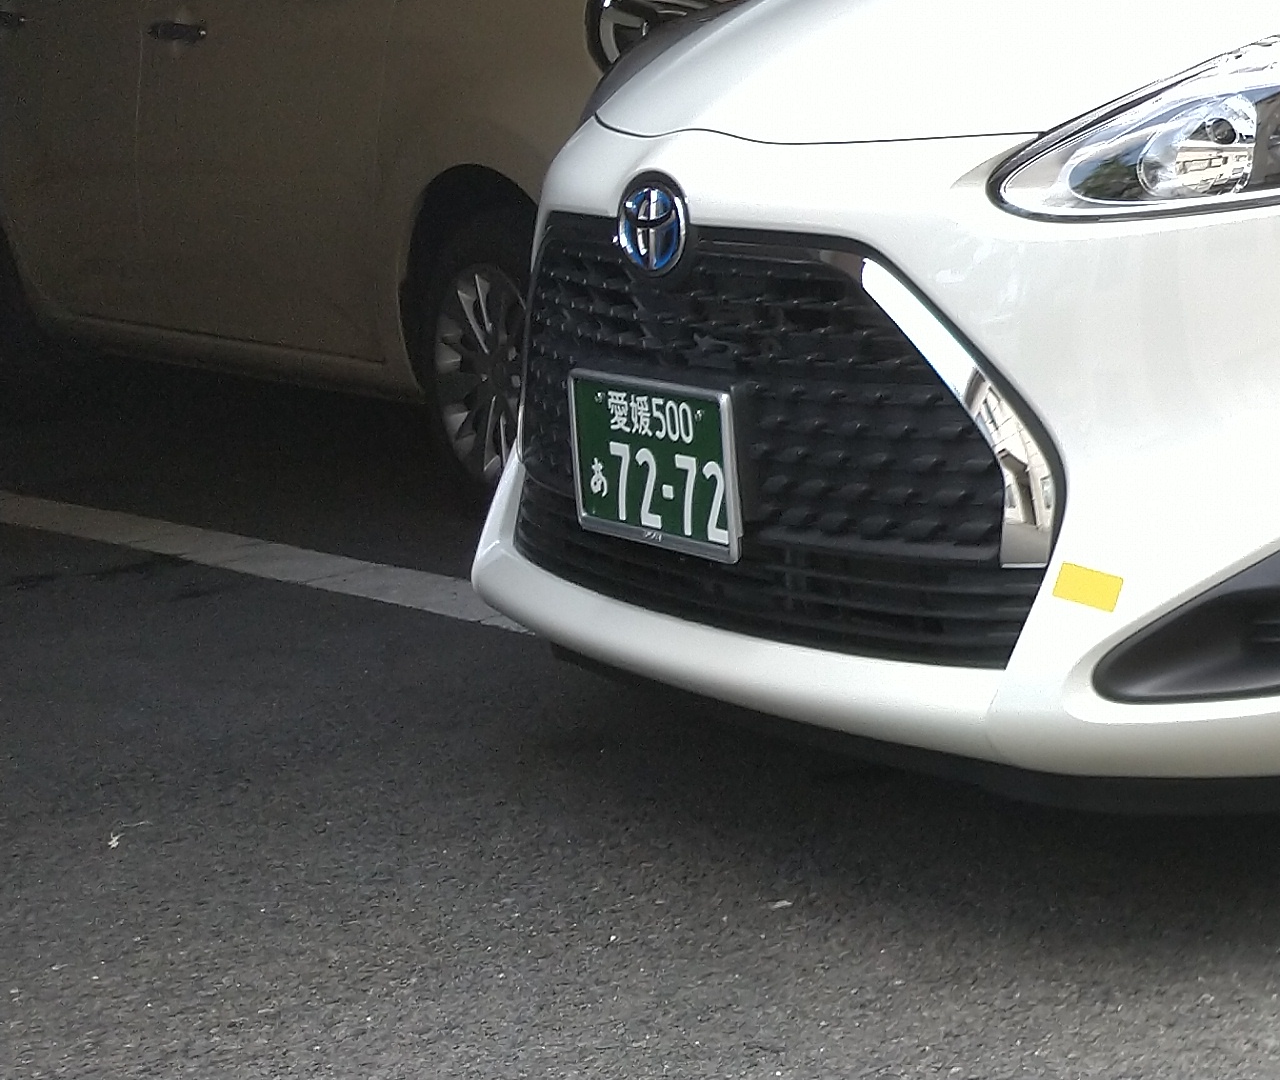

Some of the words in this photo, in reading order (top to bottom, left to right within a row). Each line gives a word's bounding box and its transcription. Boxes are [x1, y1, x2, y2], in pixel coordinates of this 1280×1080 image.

[607, 390, 694, 444] 愛媛500
[590, 457, 608, 497] あ
[609, 441, 730, 545] 72-72
